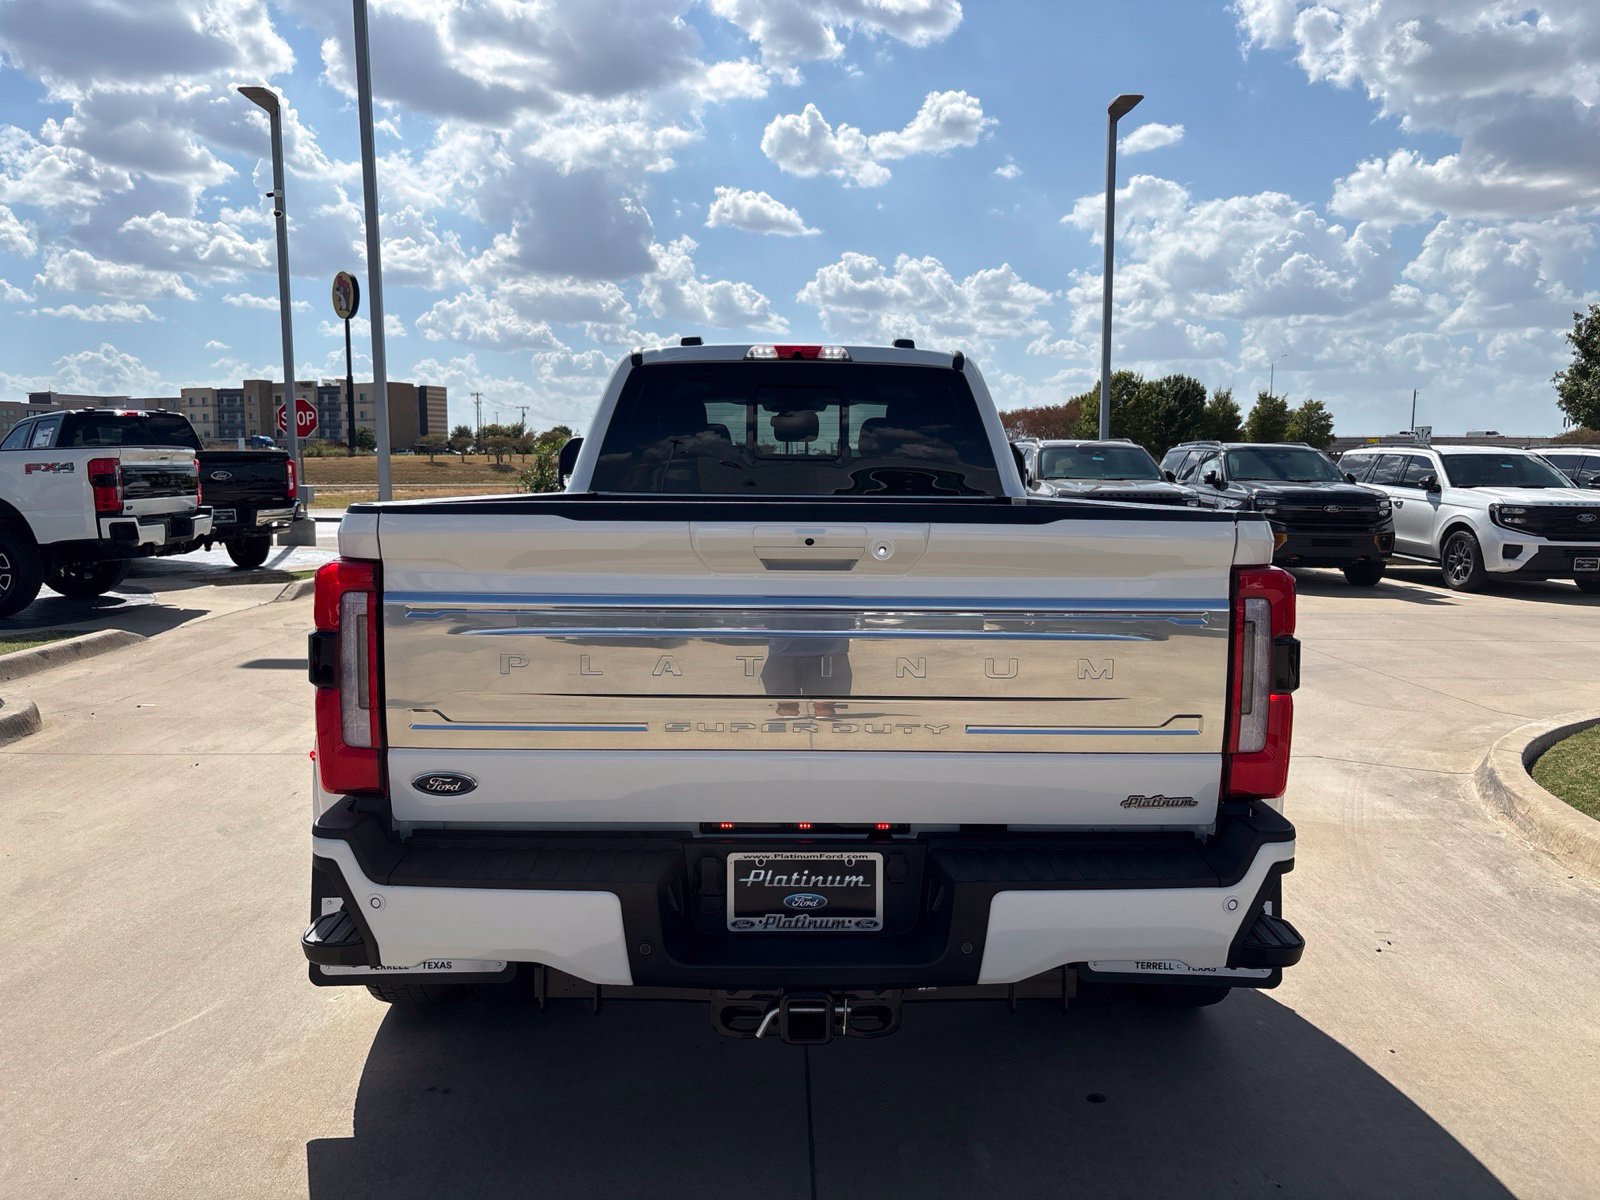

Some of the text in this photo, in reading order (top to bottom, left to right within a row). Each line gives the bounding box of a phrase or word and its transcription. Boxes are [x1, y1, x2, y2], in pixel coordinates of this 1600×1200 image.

[281, 411, 315, 426] SOP
[24, 462, 75, 475] FX4
[499, 654, 1115, 679] PLATINUM
[664, 722, 950, 734] SUPER DUTY
[426, 777, 461, 791] Ford
[1121, 795, 1198, 809] Platinum
[738, 870, 871, 887] Platinum
[791, 896, 819, 907] Ford
[763, 915, 852, 929] Platinum
[423, 962, 452, 970] TEXAS
[1135, 962, 1174, 971] TERRELL
